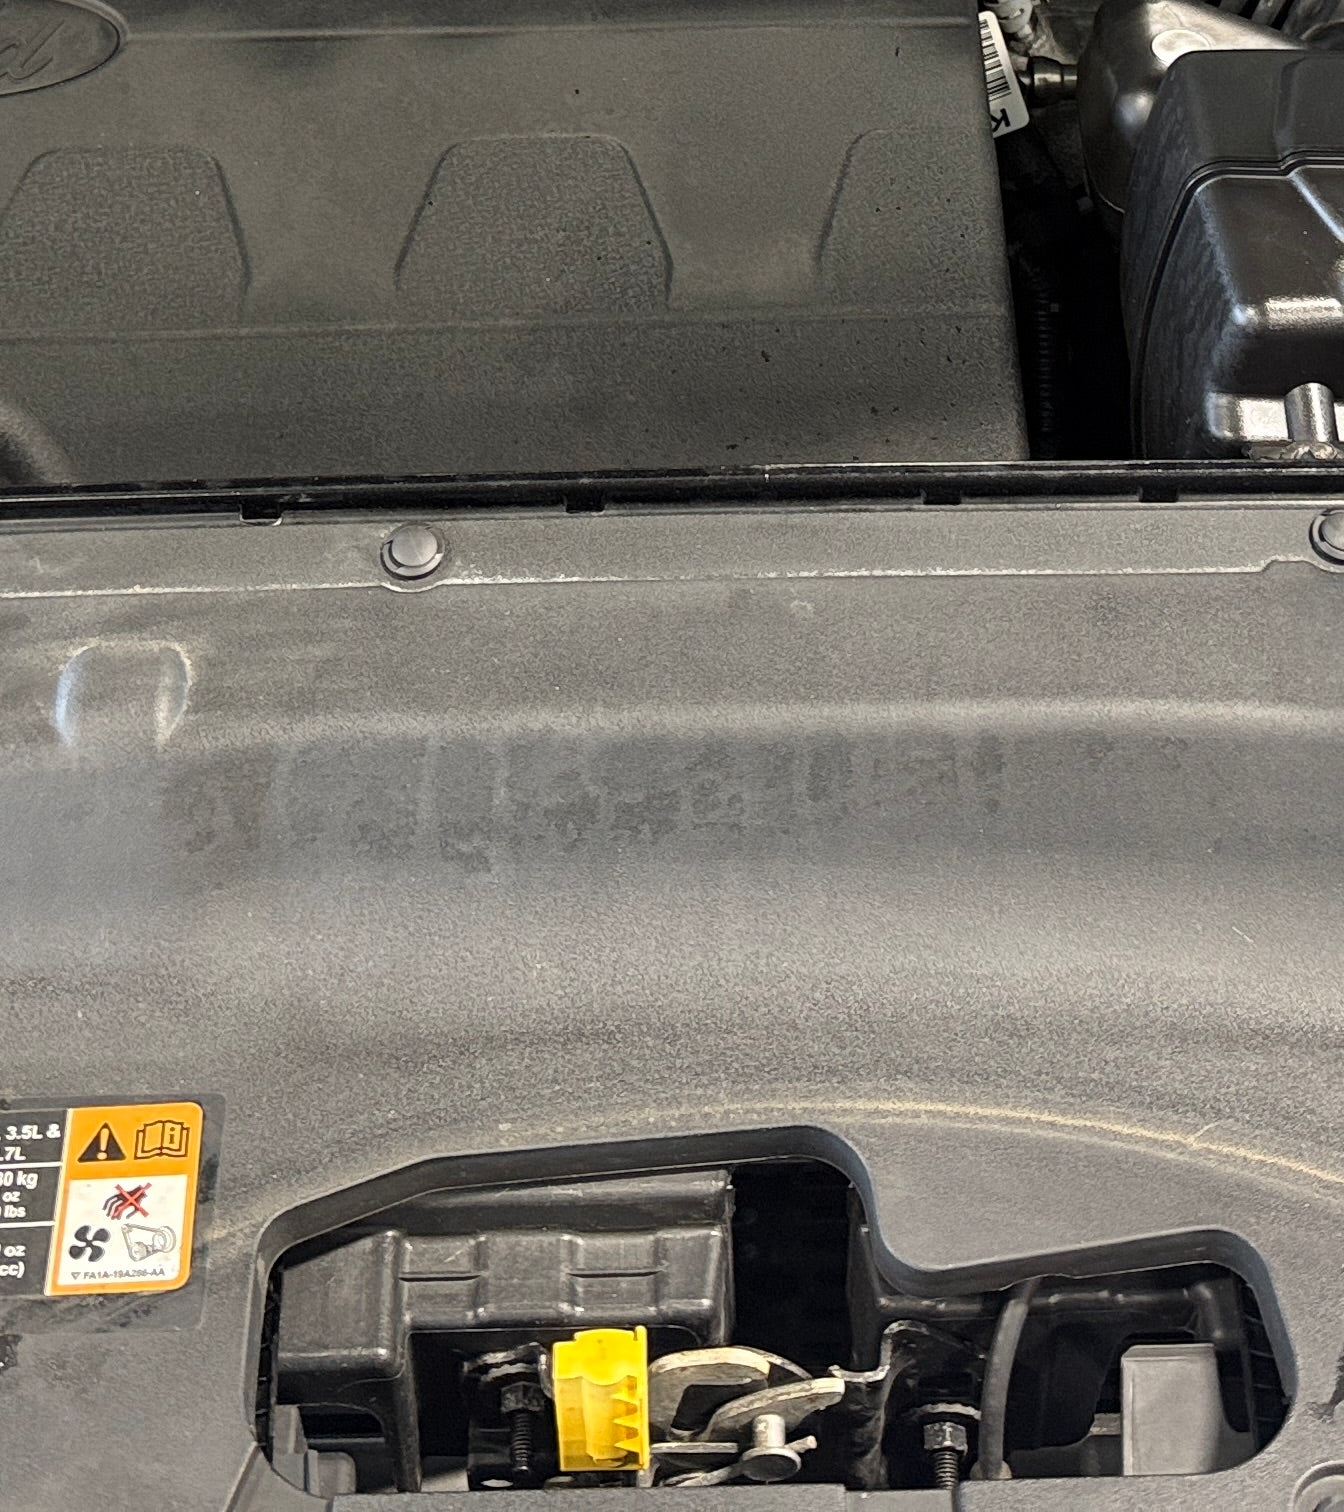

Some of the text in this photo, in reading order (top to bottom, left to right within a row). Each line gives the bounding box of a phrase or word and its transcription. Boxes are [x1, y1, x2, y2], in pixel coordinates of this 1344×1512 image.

[5, 1125, 43, 1140] 3.5L
[46, 1124, 61, 1138] &
[16, 1170, 38, 1189] kg
[2, 1191, 20, 1202] oz
[4, 1205, 26, 1218] lbs
[4, 1245, 26, 1257] oz
